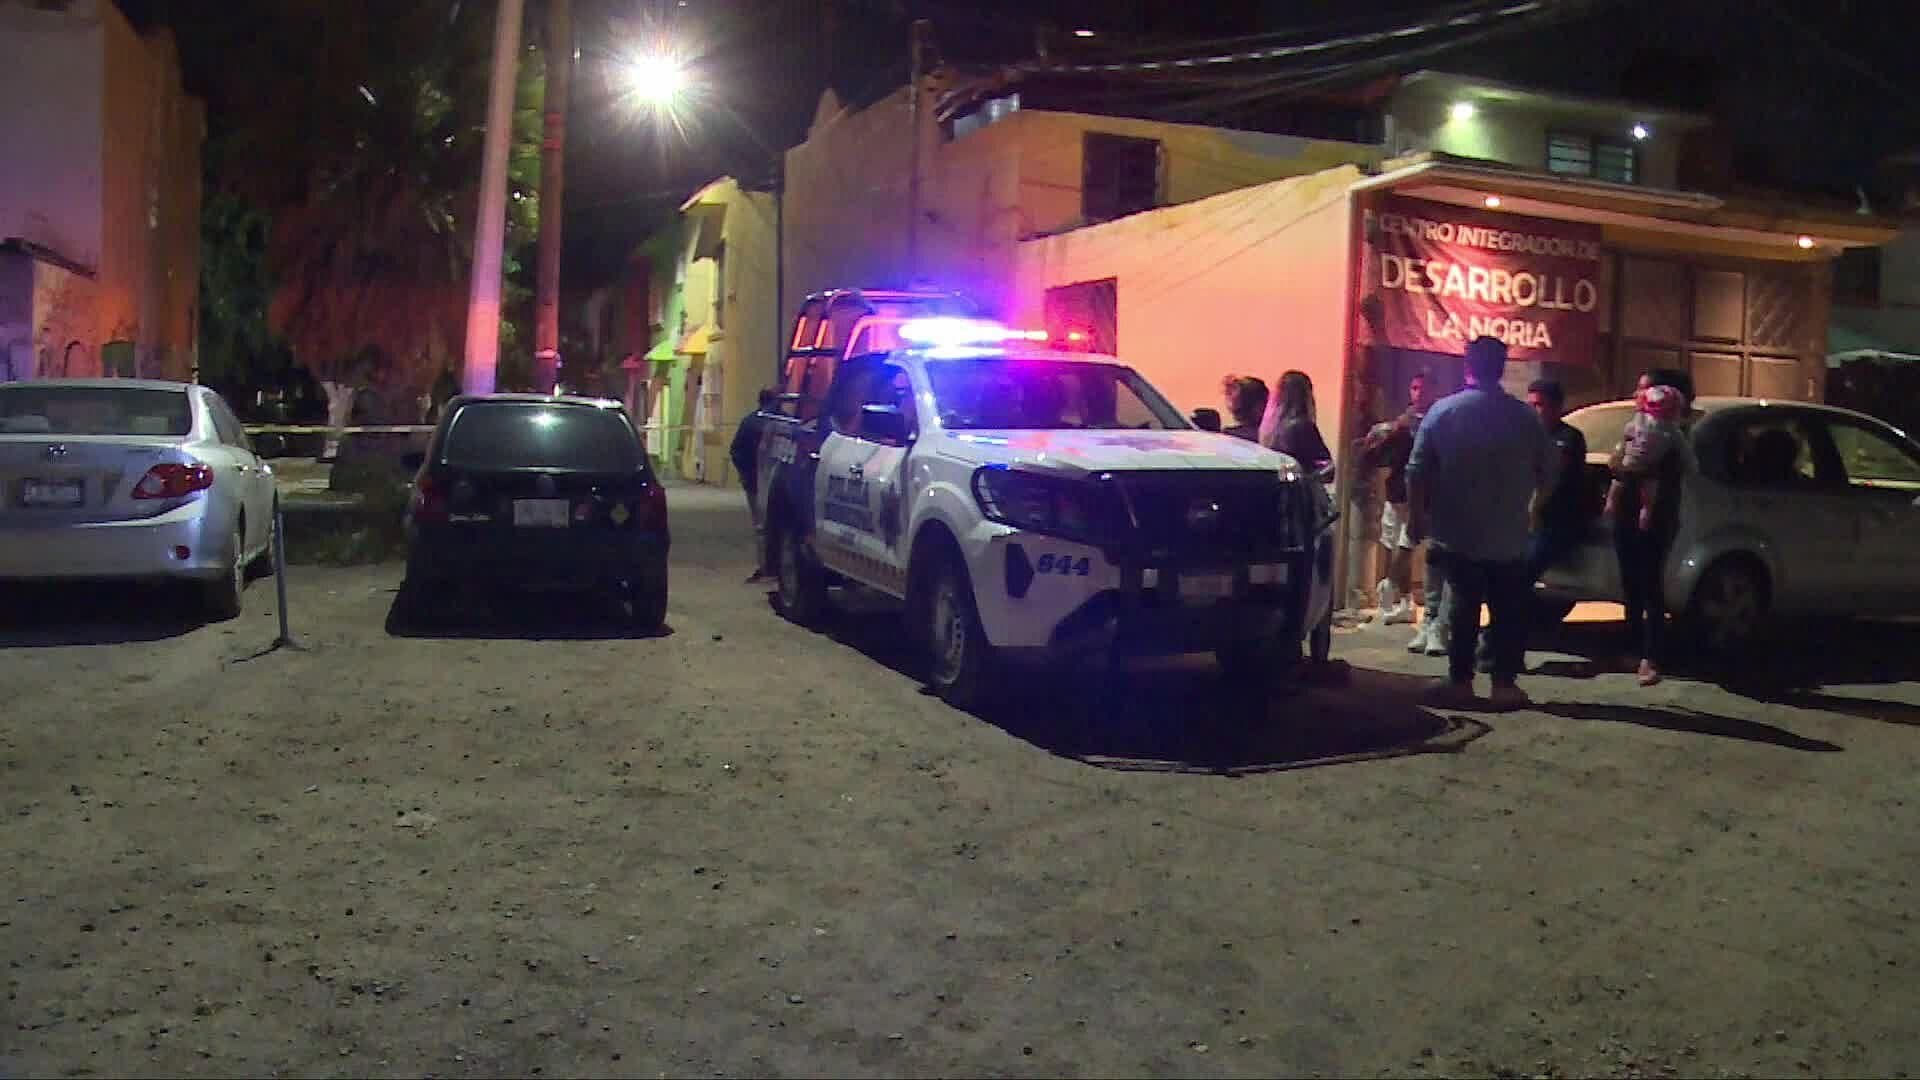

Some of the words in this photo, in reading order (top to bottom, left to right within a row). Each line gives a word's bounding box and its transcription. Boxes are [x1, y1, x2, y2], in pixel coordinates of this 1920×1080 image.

[1380, 214, 1452, 243] CENTRO
[1457, 224, 1575, 256] INTEGRADOR
[1380, 254, 1597, 313] DESARROLLO
[1426, 310, 1463, 341] LA
[1469, 316, 1552, 348] NORIA
